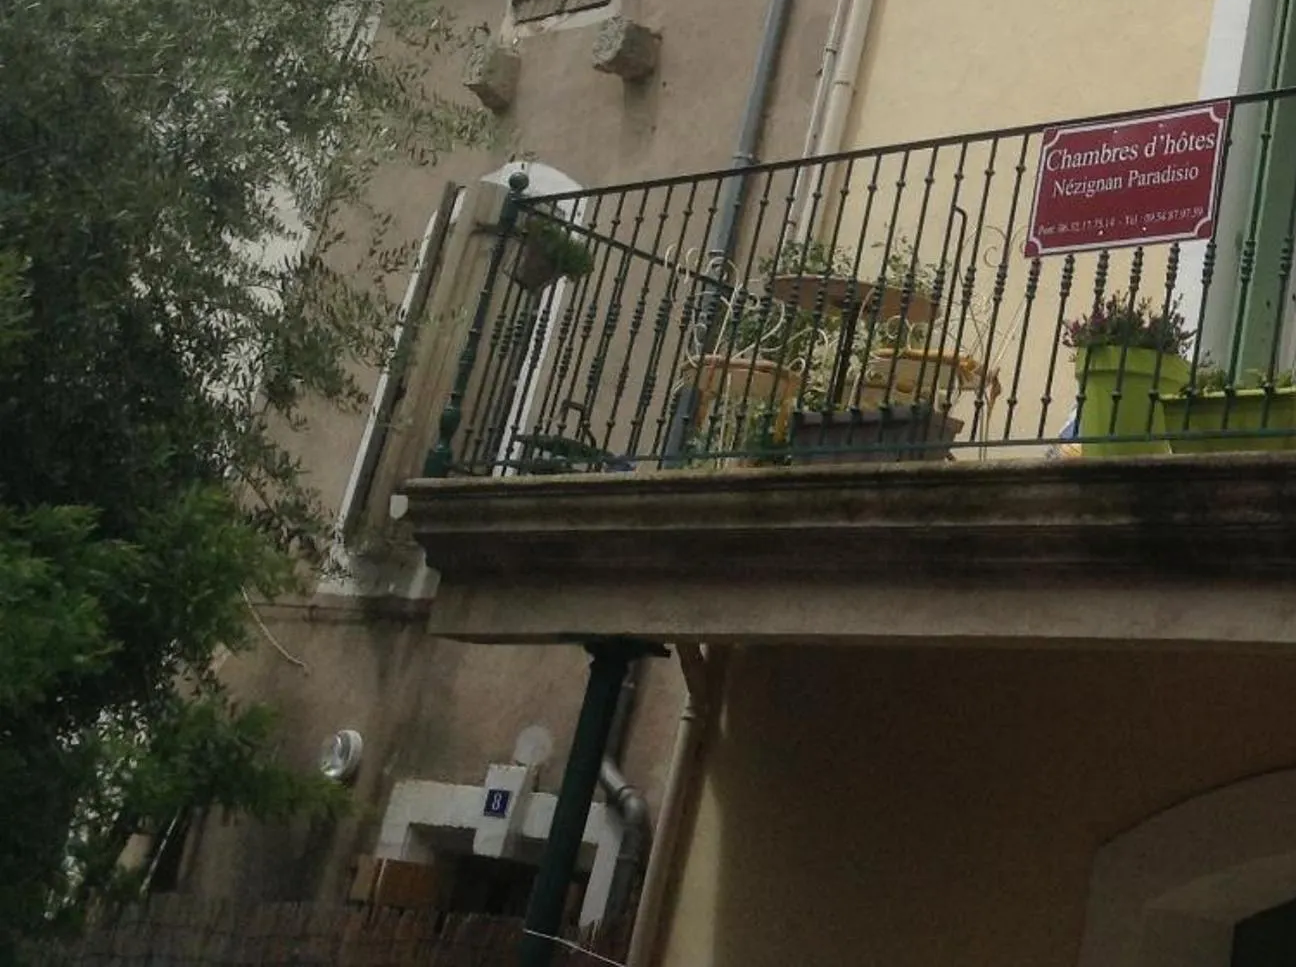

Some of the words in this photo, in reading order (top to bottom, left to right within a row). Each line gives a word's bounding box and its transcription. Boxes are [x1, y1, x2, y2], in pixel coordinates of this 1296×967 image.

[1046, 143, 1139, 172] Chambres
[1052, 175, 1123, 199] Nézignan
[1127, 163, 1200, 189] Paradisio
[491, 792, 502, 811] 8
